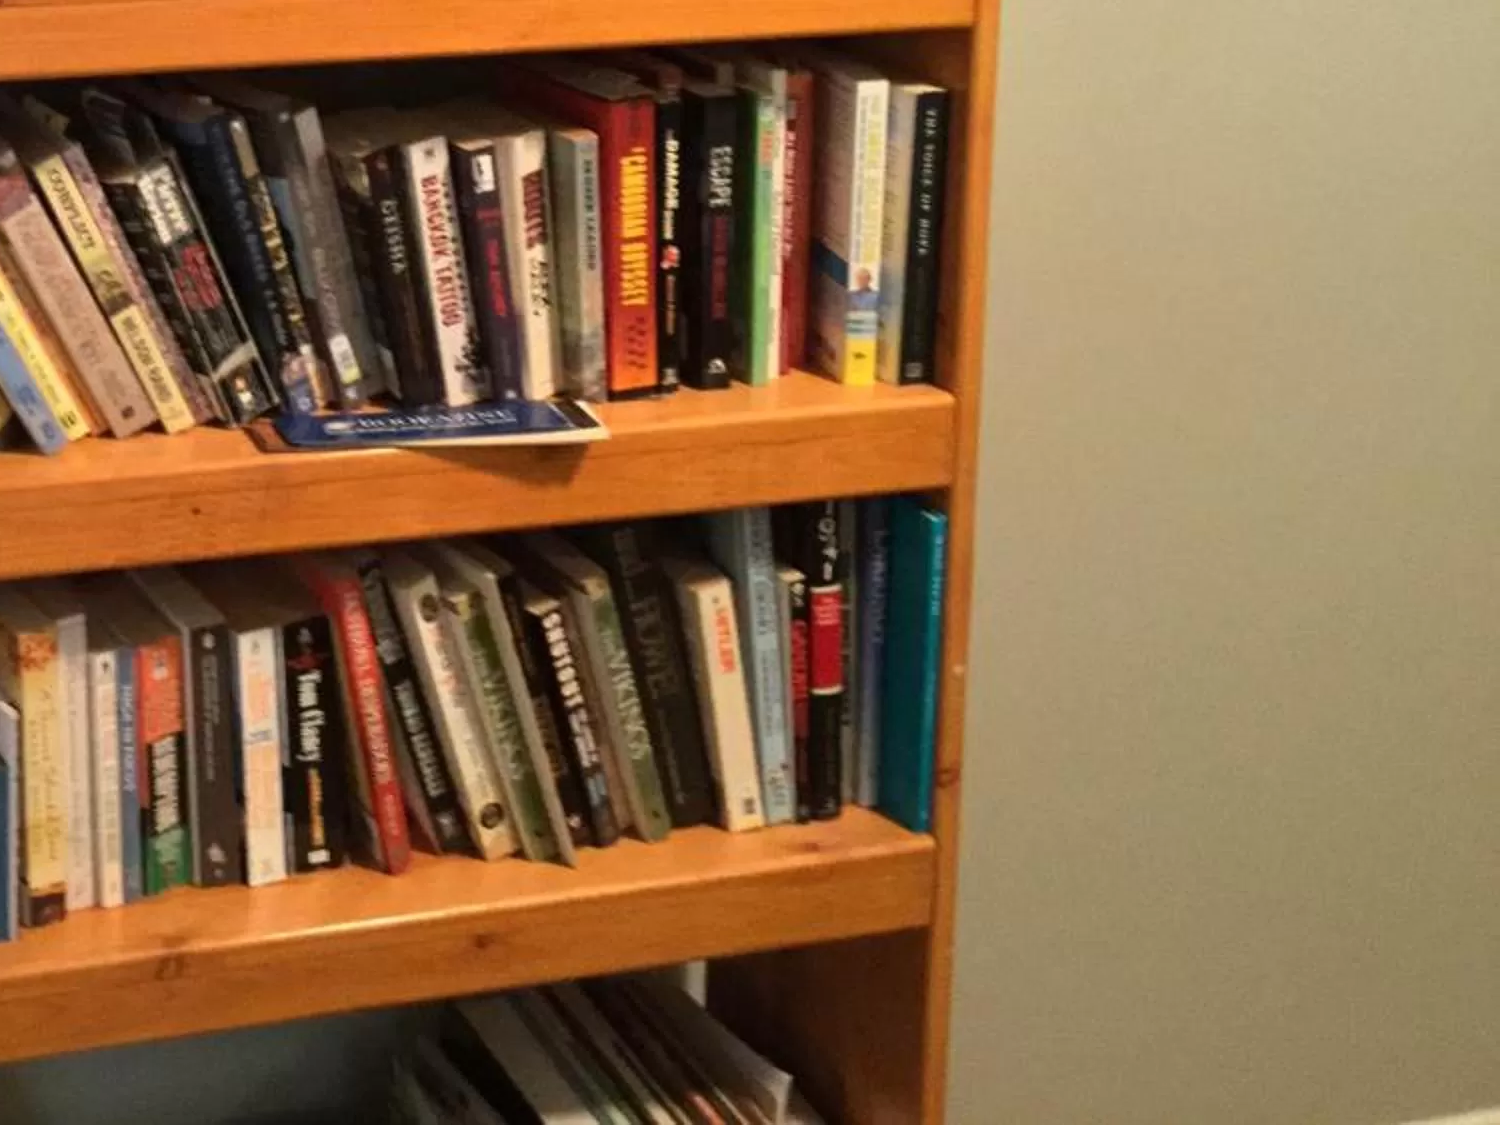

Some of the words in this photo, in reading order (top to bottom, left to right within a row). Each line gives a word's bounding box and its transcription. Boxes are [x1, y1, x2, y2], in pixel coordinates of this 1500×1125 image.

[923, 109, 938, 138] THE
[618, 154, 646, 238] CAMBODIAN
[663, 140, 679, 209] DAMAGE
[708, 146, 733, 208] ESCAPE
[921, 143, 936, 187] VOICE
[151, 166, 190, 234] Pierre
[419, 174, 451, 262] BANGKOK
[920, 193, 934, 212] OF
[379, 199, 407, 275] GEISHA
[916, 218, 930, 257] HOPE
[434, 266, 463, 329] TATTOO
[619, 242, 648, 306] ODYSSEY
[299, 671, 324, 708] Tom
[541, 612, 582, 707] SHUTOUT
[297, 712, 325, 763] Clancy
[608, 656, 651, 760] VIKINGS
